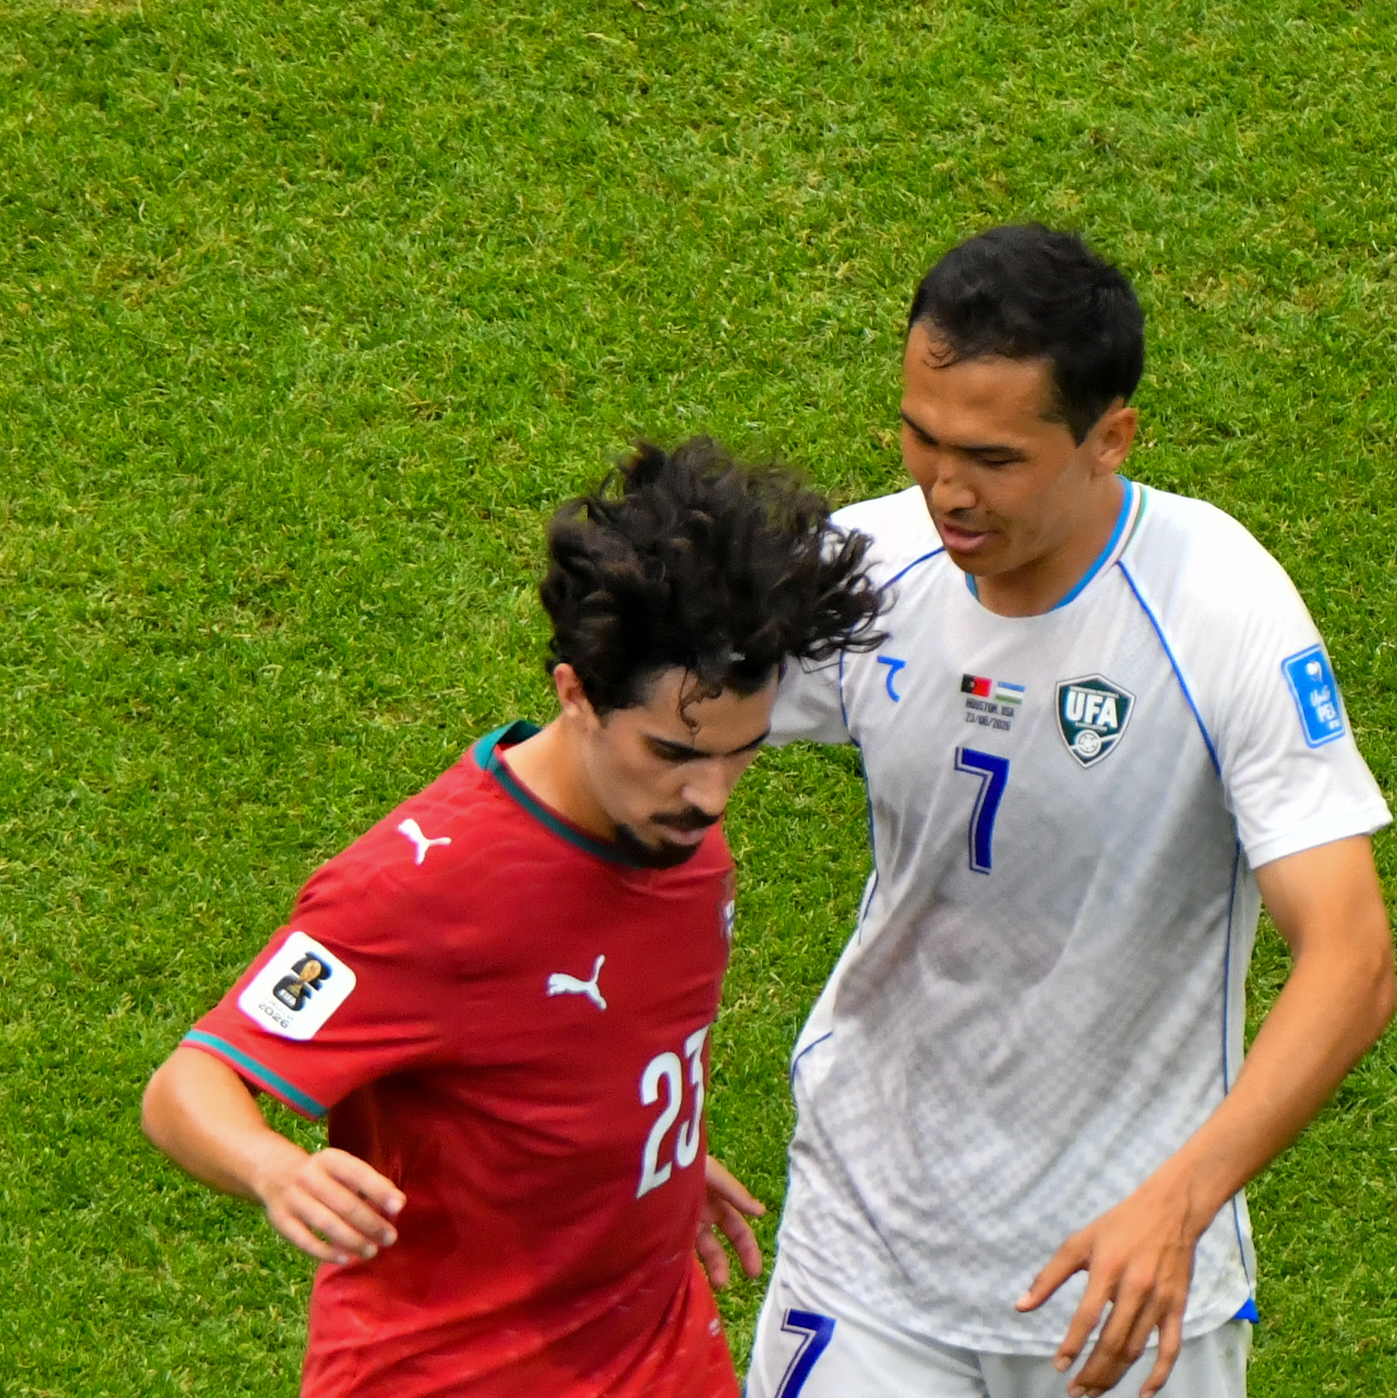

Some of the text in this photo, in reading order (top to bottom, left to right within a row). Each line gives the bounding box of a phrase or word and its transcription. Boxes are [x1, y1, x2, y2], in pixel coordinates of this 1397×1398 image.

[1065, 690, 1118, 729] UFA
[954, 745, 1010, 875] 7
[258, 1002, 290, 1029] 2026
[636, 1024, 710, 1199] 23
